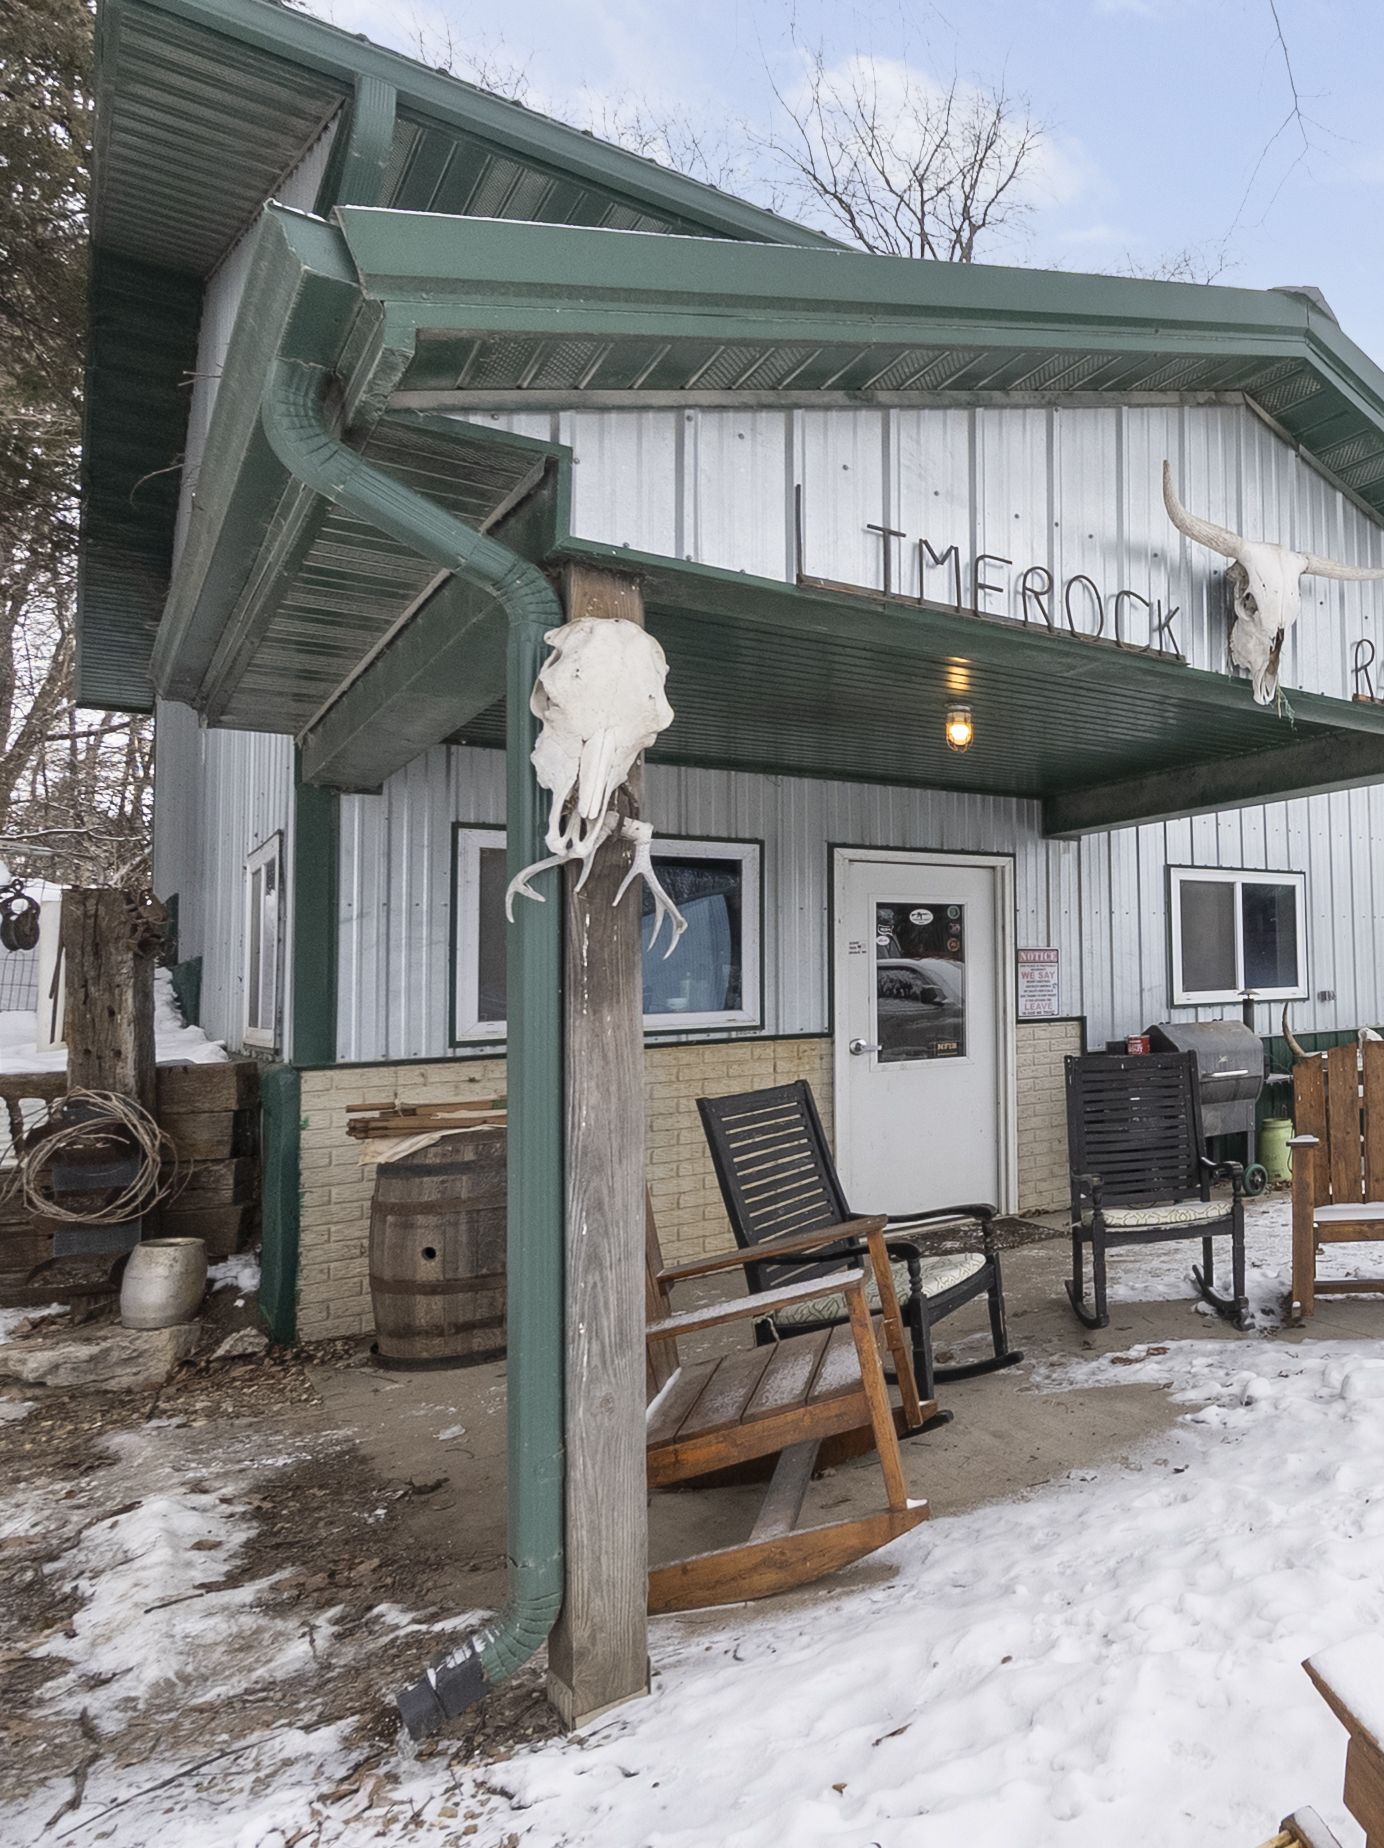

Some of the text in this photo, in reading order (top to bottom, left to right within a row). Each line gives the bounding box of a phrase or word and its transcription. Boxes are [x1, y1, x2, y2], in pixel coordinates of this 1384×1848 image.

[1019, 950, 1057, 961] NOTICE
[1021, 971, 1056, 980] WE SAY
[1024, 1002, 1053, 1011] LEAVE
